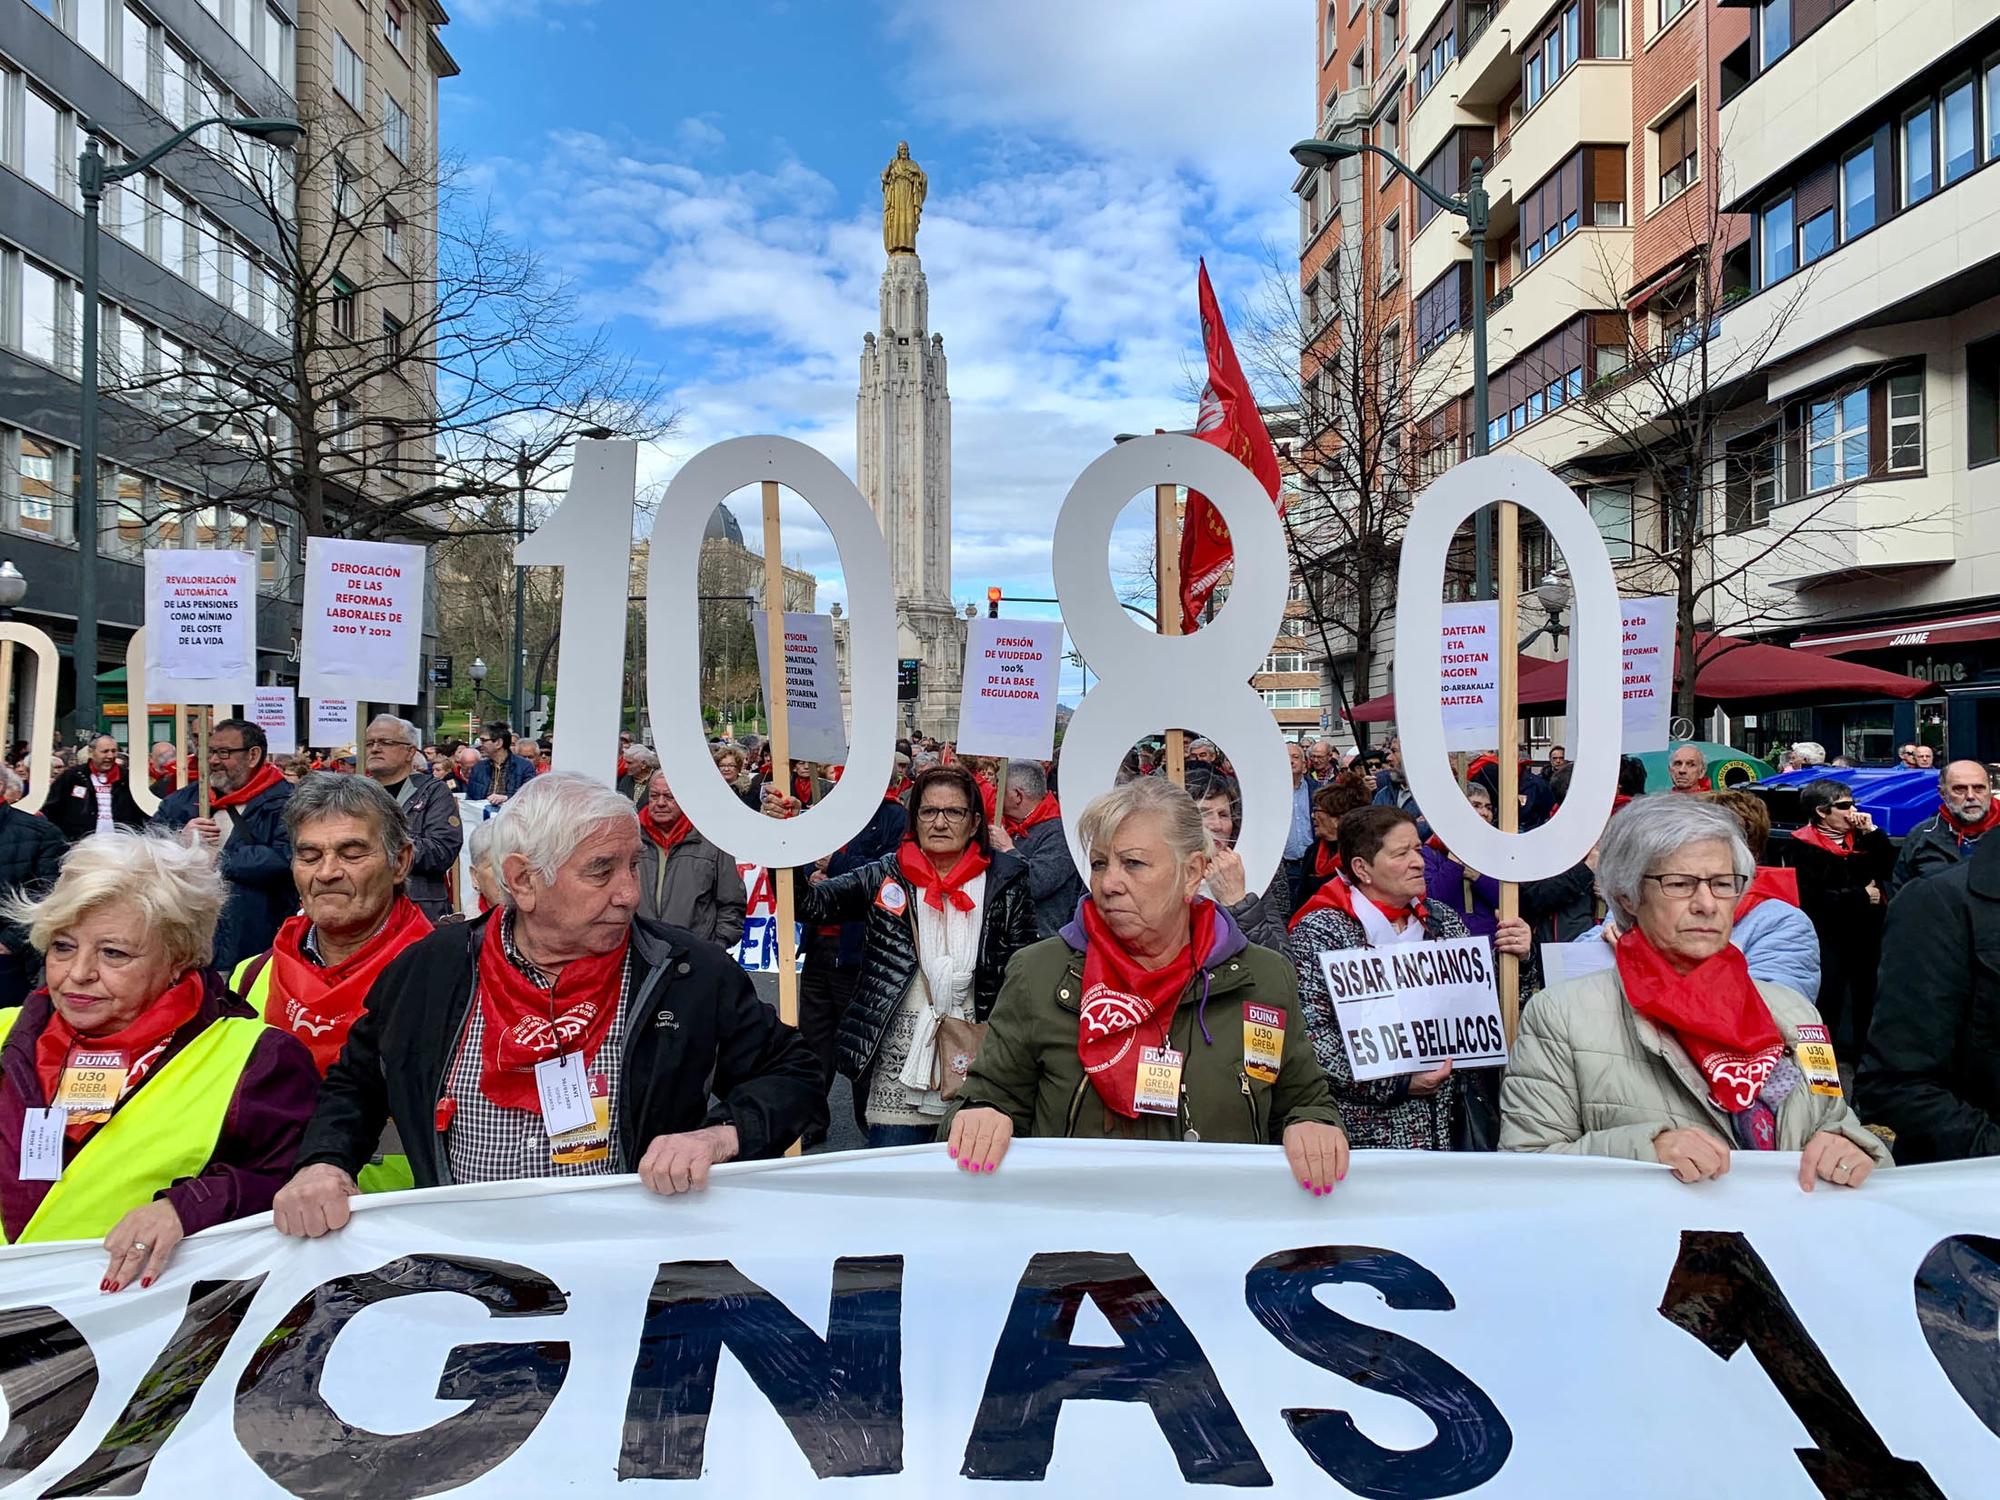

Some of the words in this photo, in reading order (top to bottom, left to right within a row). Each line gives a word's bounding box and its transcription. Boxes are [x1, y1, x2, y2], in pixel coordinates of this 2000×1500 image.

[331, 562, 401, 577] DEROGACIÓN
[165, 574, 237, 585] REVALORIZACIÓN
[348, 579, 361, 589] DE
[363, 580, 383, 591] LAS
[174, 586, 228, 597] AUTOMÁTICA
[164, 601, 175, 609] DE
[176, 601, 192, 609] LAS
[193, 600, 239, 609] PENSIONES
[335, 593, 393, 608] REFORMAS
[170, 612, 197, 621] COMO
[326, 607, 387, 622] LABORALES
[388, 613, 403, 623] DE
[1631, 616, 1646, 626] eta
[180, 624, 196, 633] DEL
[197, 624, 222, 633] COSTE
[332, 625, 357, 634] 2010
[359, 625, 367, 635] Y
[369, 628, 392, 637] 2012
[1442, 624, 1486, 637] DATETAN
[178, 637, 190, 645] DE
[191, 637, 202, 645] LA
[203, 637, 224, 645] VIDA
[784, 632, 808, 641] NTSIOEN
[996, 636, 1034, 648] PENSIÓN
[1889, 632, 1930, 646] JAIME
[1447, 640, 1465, 650] ETA
[784, 654, 818, 667] OMATIKOA,
[985, 650, 997, 659] DE
[998, 651, 1043, 661] VIUDEDAD
[785, 665, 813, 676] ZITZAREN
[1001, 663, 1024, 673] 100%
[988, 675, 1000, 684] DE
[1000, 676, 1012, 685] LA
[1013, 677, 1036, 687] BASE
[981, 688, 1040, 700] REGULADORA
[1441, 695, 1484, 706] MAITZEA
[1329, 957, 1393, 999] SISAR
[1391, 946, 1492, 991] ANCIANOS,
[1249, 1009, 1279, 1025] DUINA
[1252, 1039, 1276, 1051] GREBA
[1347, 1026, 1380, 1067] ES
[1378, 1021, 1414, 1062] DE
[1411, 1014, 1503, 1058] BELLACOS
[75, 1056, 121, 1066] DUINA
[70, 1083, 108, 1093] GREBA
[1145, 1079, 1175, 1090] GREBA
